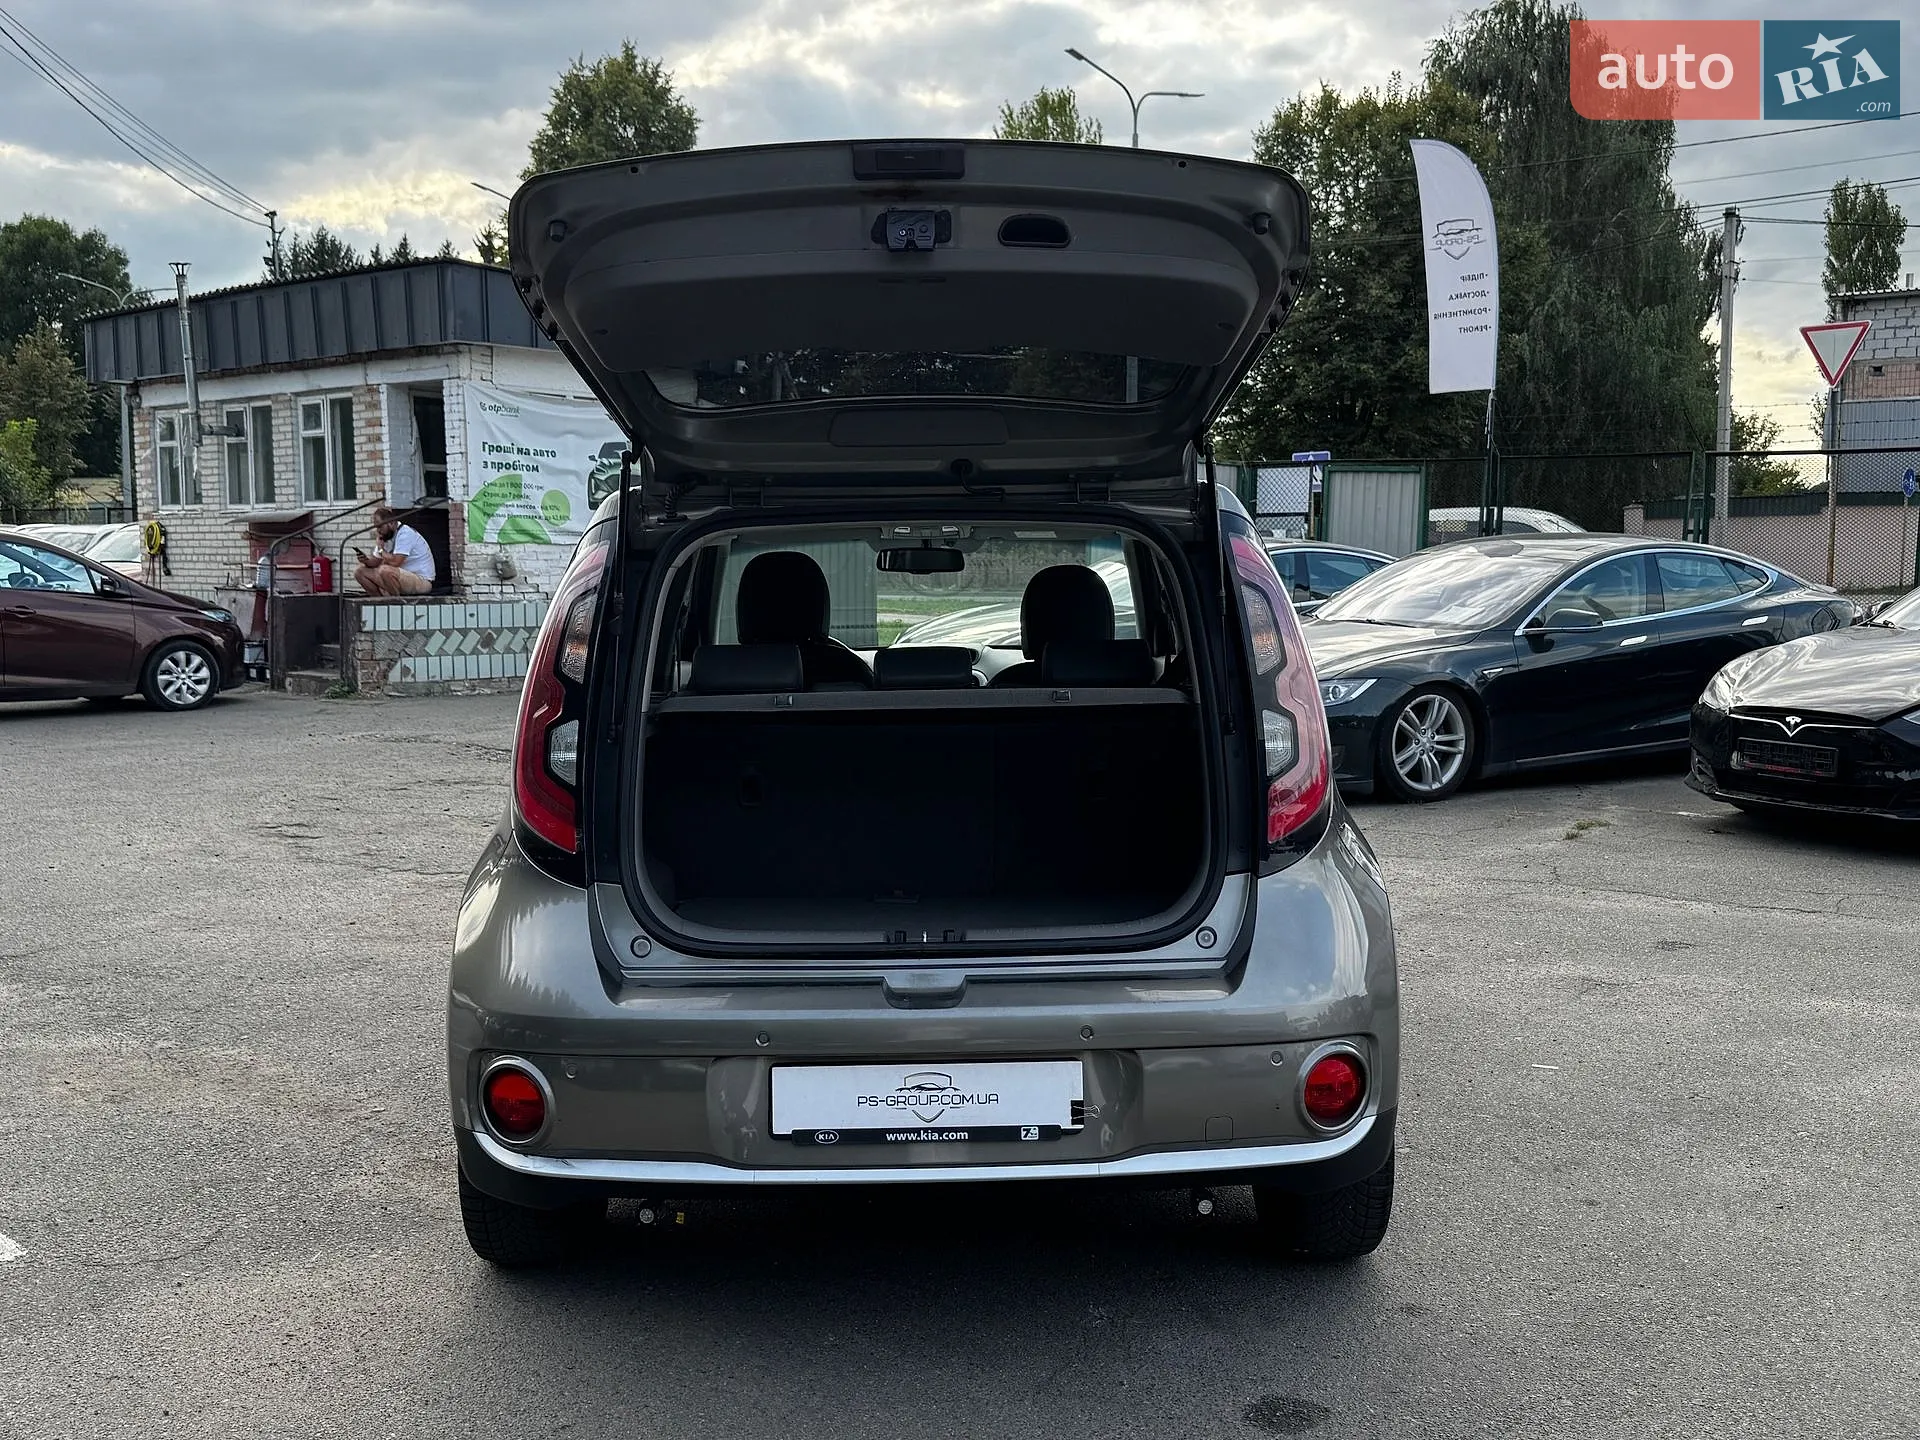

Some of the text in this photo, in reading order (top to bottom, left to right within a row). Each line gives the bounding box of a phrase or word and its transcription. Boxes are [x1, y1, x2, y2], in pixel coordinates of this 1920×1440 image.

[482, 441, 557, 458] Гроші на авто
[482, 459, 540, 473] з пробігом
[857, 1093, 999, 1108] PS-GROUP.COM.UA
[817, 1132, 836, 1141] KIA
[886, 1130, 969, 1141] www.kia.com
